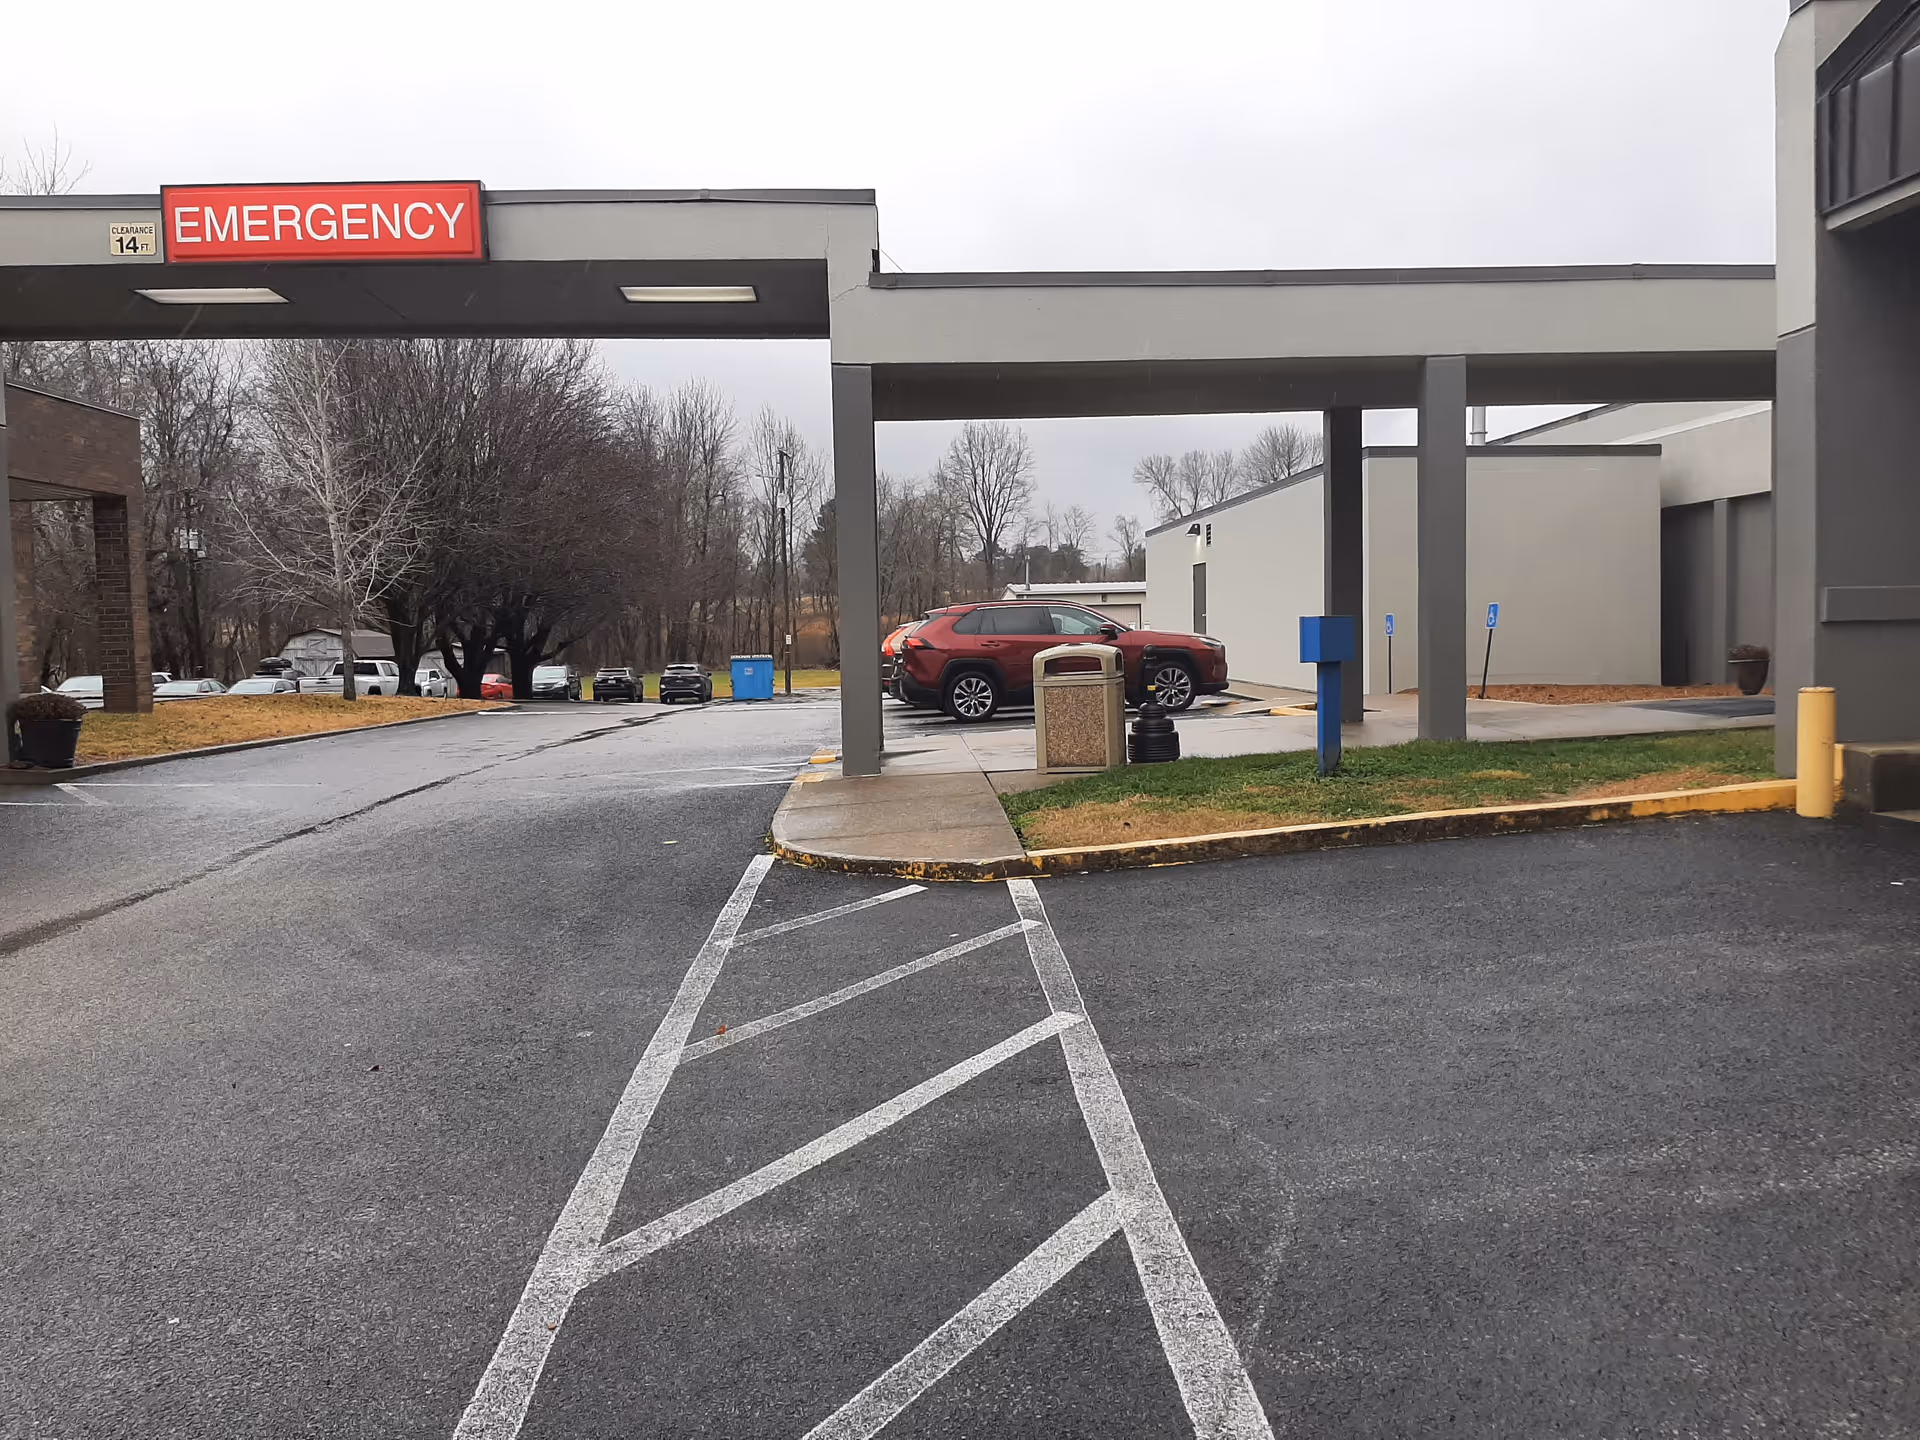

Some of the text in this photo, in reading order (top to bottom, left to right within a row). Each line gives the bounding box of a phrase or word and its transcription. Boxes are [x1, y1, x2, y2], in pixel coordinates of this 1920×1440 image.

[111, 226, 154, 235] CLEARANCE
[174, 202, 465, 243] EMERGENCY
[115, 236, 140, 254] 14
